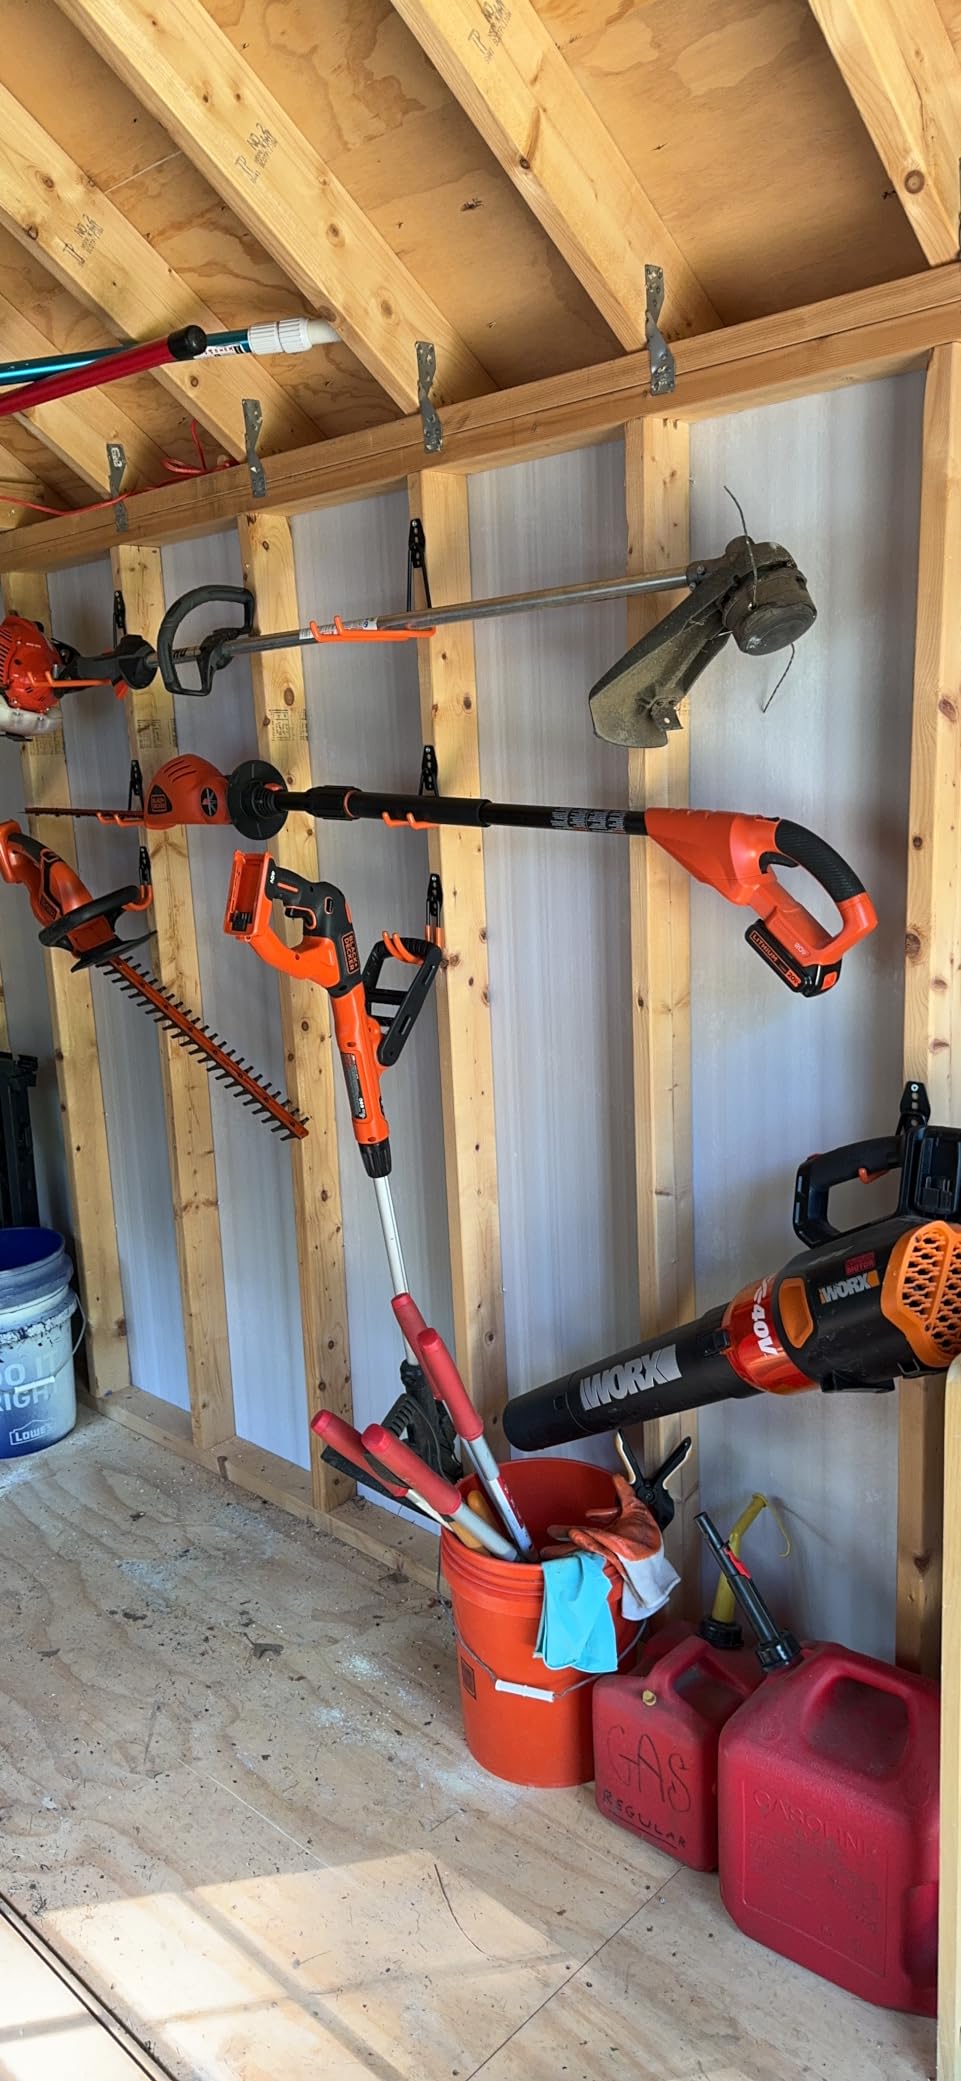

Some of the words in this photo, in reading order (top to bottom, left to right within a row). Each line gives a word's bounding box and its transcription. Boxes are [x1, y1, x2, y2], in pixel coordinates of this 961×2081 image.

[751, 934, 778, 962] LITHIUM
[820, 1271, 872, 1304] WORX
[751, 1304, 779, 1356] 40V
[0, 1363, 26, 1386] O
[582, 1346, 671, 1410] WORX
[606, 1724, 692, 1813] GAS
[602, 1789, 686, 1849] REGULAR
